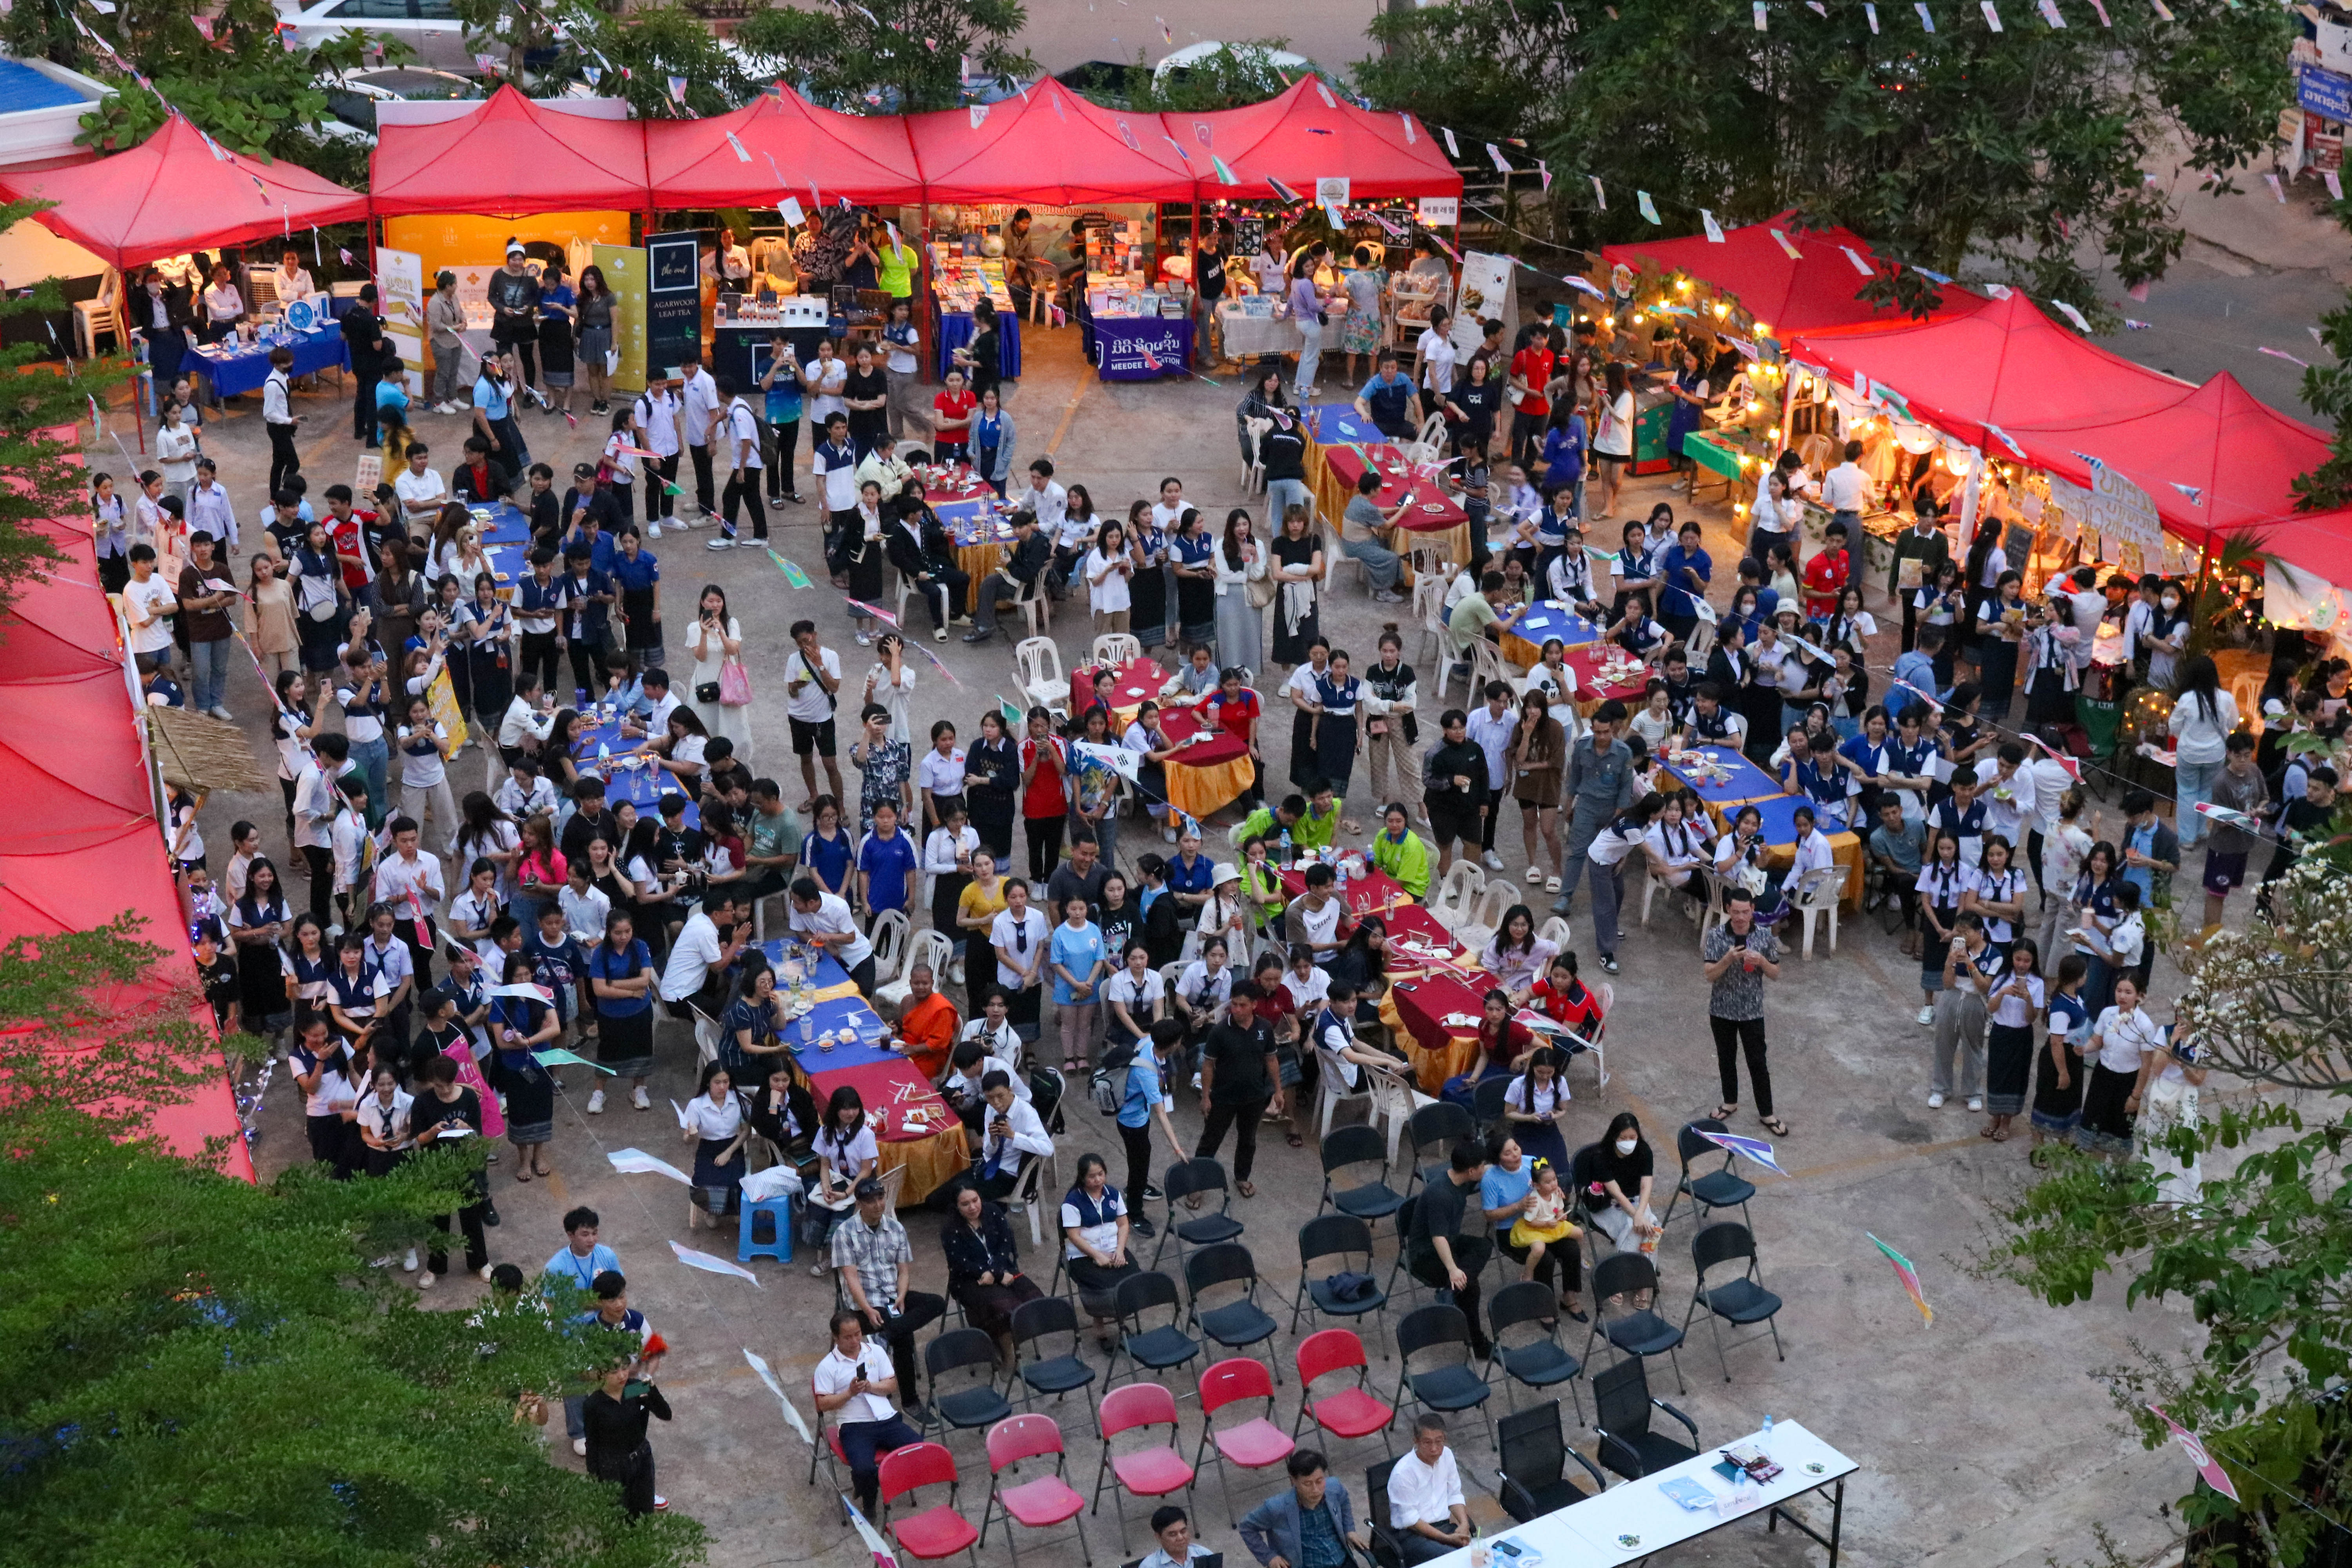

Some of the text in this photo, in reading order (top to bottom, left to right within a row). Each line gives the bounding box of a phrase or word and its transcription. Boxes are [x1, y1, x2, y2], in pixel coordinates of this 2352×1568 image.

[654, 299, 696, 309] AGARWOOD
[1111, 357, 1180, 370] MEEDEE EATION
[1312, 915, 1332, 931] CELINE
